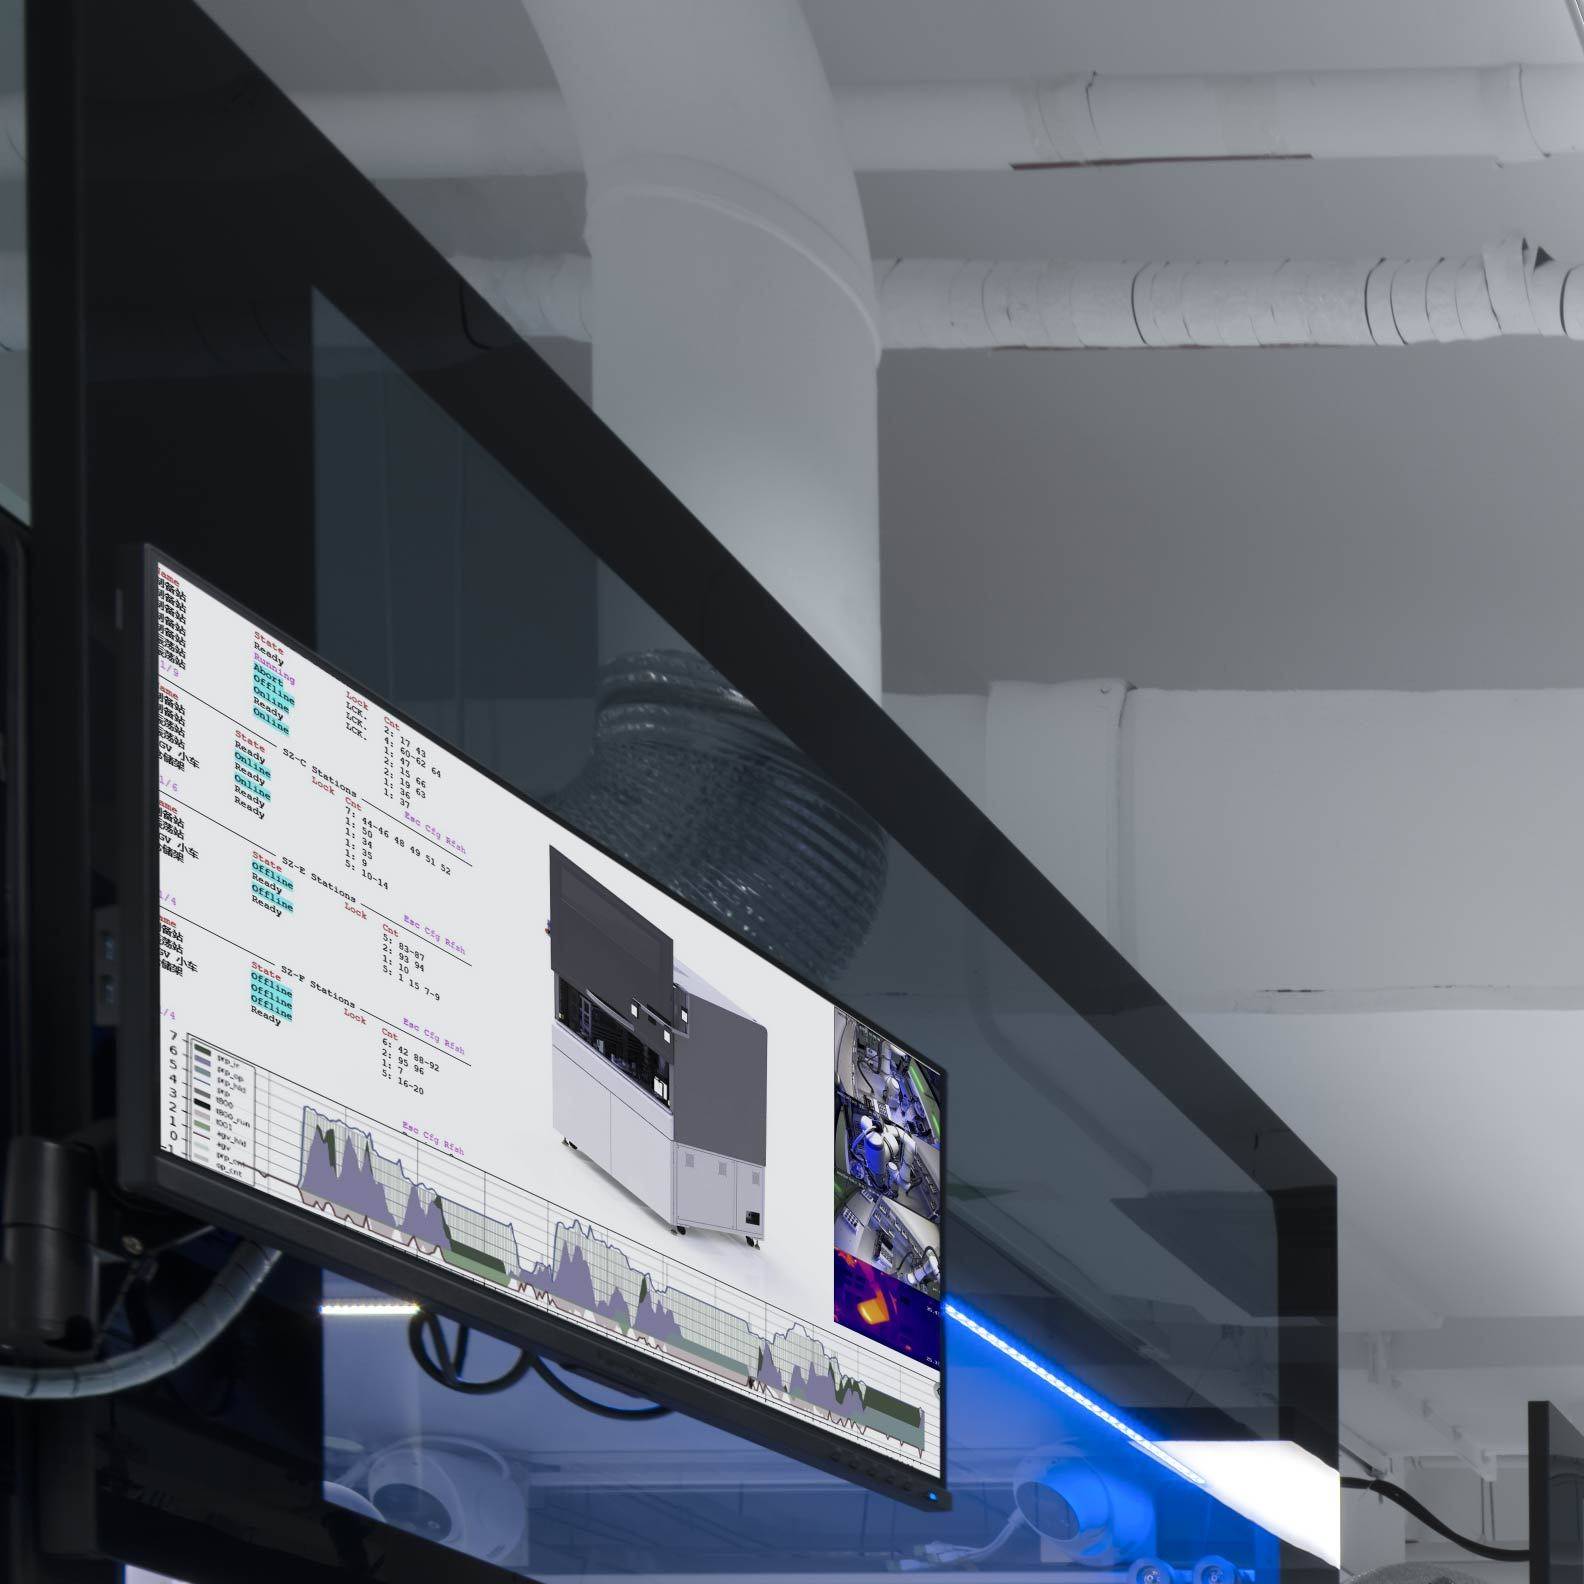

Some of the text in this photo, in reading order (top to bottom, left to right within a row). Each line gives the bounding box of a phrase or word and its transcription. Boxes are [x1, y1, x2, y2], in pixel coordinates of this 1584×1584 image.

[254, 630, 285, 656] State
[254, 641, 284, 669] Ready
[253, 663, 284, 688] Abort
[254, 652, 296, 686] Running
[253, 674, 295, 706] Offline
[253, 685, 290, 714] Online
[346, 690, 369, 712] Lock
[253, 695, 284, 723] Ready
[253, 707, 290, 735] Online
[346, 701, 367, 720] LCK.
[346, 711, 367, 731] LCK.
[345, 721, 367, 741] LCK.
[383, 716, 400, 732] Cnt
[234, 729, 266, 754] State
[234, 739, 266, 767] Ready
[384, 725, 426, 759] 2: 17 43
[234, 751, 272, 779] Online
[384, 746, 411, 768] 1: 47
[384, 736, 441, 779] 4: 60-62 64
[234, 761, 266, 788] Ready
[282, 747, 357, 798] SZ-C Stations
[383, 756, 426, 789] 2: 15 66
[383, 767, 426, 799] 2: 19 63
[234, 774, 271, 801] Online
[234, 784, 265, 811] Ready
[311, 775, 335, 796] Lock
[383, 777, 411, 800] 1: 36
[383, 787, 410, 809] 1: 37
[234, 795, 265, 821] Ready
[344, 796, 362, 812] Cnt
[345, 816, 373, 839] 1: 50
[345, 827, 373, 850] 1: 34
[345, 805, 451, 876] 7: 44-46 48 49 51 52
[345, 838, 373, 860] 1: 35
[252, 850, 283, 873] State
[345, 848, 368, 867] 1: 9
[251, 861, 294, 890] Offline
[252, 871, 283, 897] Ready
[281, 856, 356, 903] SZ-E Stations
[344, 859, 389, 890] 5: 10-14
[251, 883, 294, 913] Offline
[251, 894, 282, 919] Ready
[344, 901, 368, 920] Lock
[382, 923, 399, 938] Cnt
[382, 933, 425, 962] 5: 83-87
[382, 943, 425, 972] 2: 93 94
[251, 961, 282, 982] State
[382, 954, 410, 975] 1: 10
[250, 971, 293, 999] Offline
[281, 965, 355, 1009] SZ-F Stations
[382, 964, 440, 1001] 5: 1 15 7-9
[250, 983, 293, 1010] Offline
[250, 994, 293, 1021] Offline
[250, 1004, 282, 1028] Ready
[343, 1007, 367, 1025] Lock
[169, 1029, 178, 1041] 7
[381, 1027, 399, 1042] Cnt
[169, 1045, 178, 1056] 6
[381, 1048, 425, 1076] 2: 95 96
[382, 1037, 440, 1072] 6: 42 88-92
[168, 1058, 178, 1070] 5
[382, 1058, 404, 1075] 1: 7
[169, 1074, 177, 1084] 4
[381, 1068, 424, 1095] 5: 16-20
[169, 1086, 178, 1099] 3
[168, 1101, 177, 1114] 2
[169, 1115, 177, 1128] 1
[169, 1130, 178, 1142] 0
